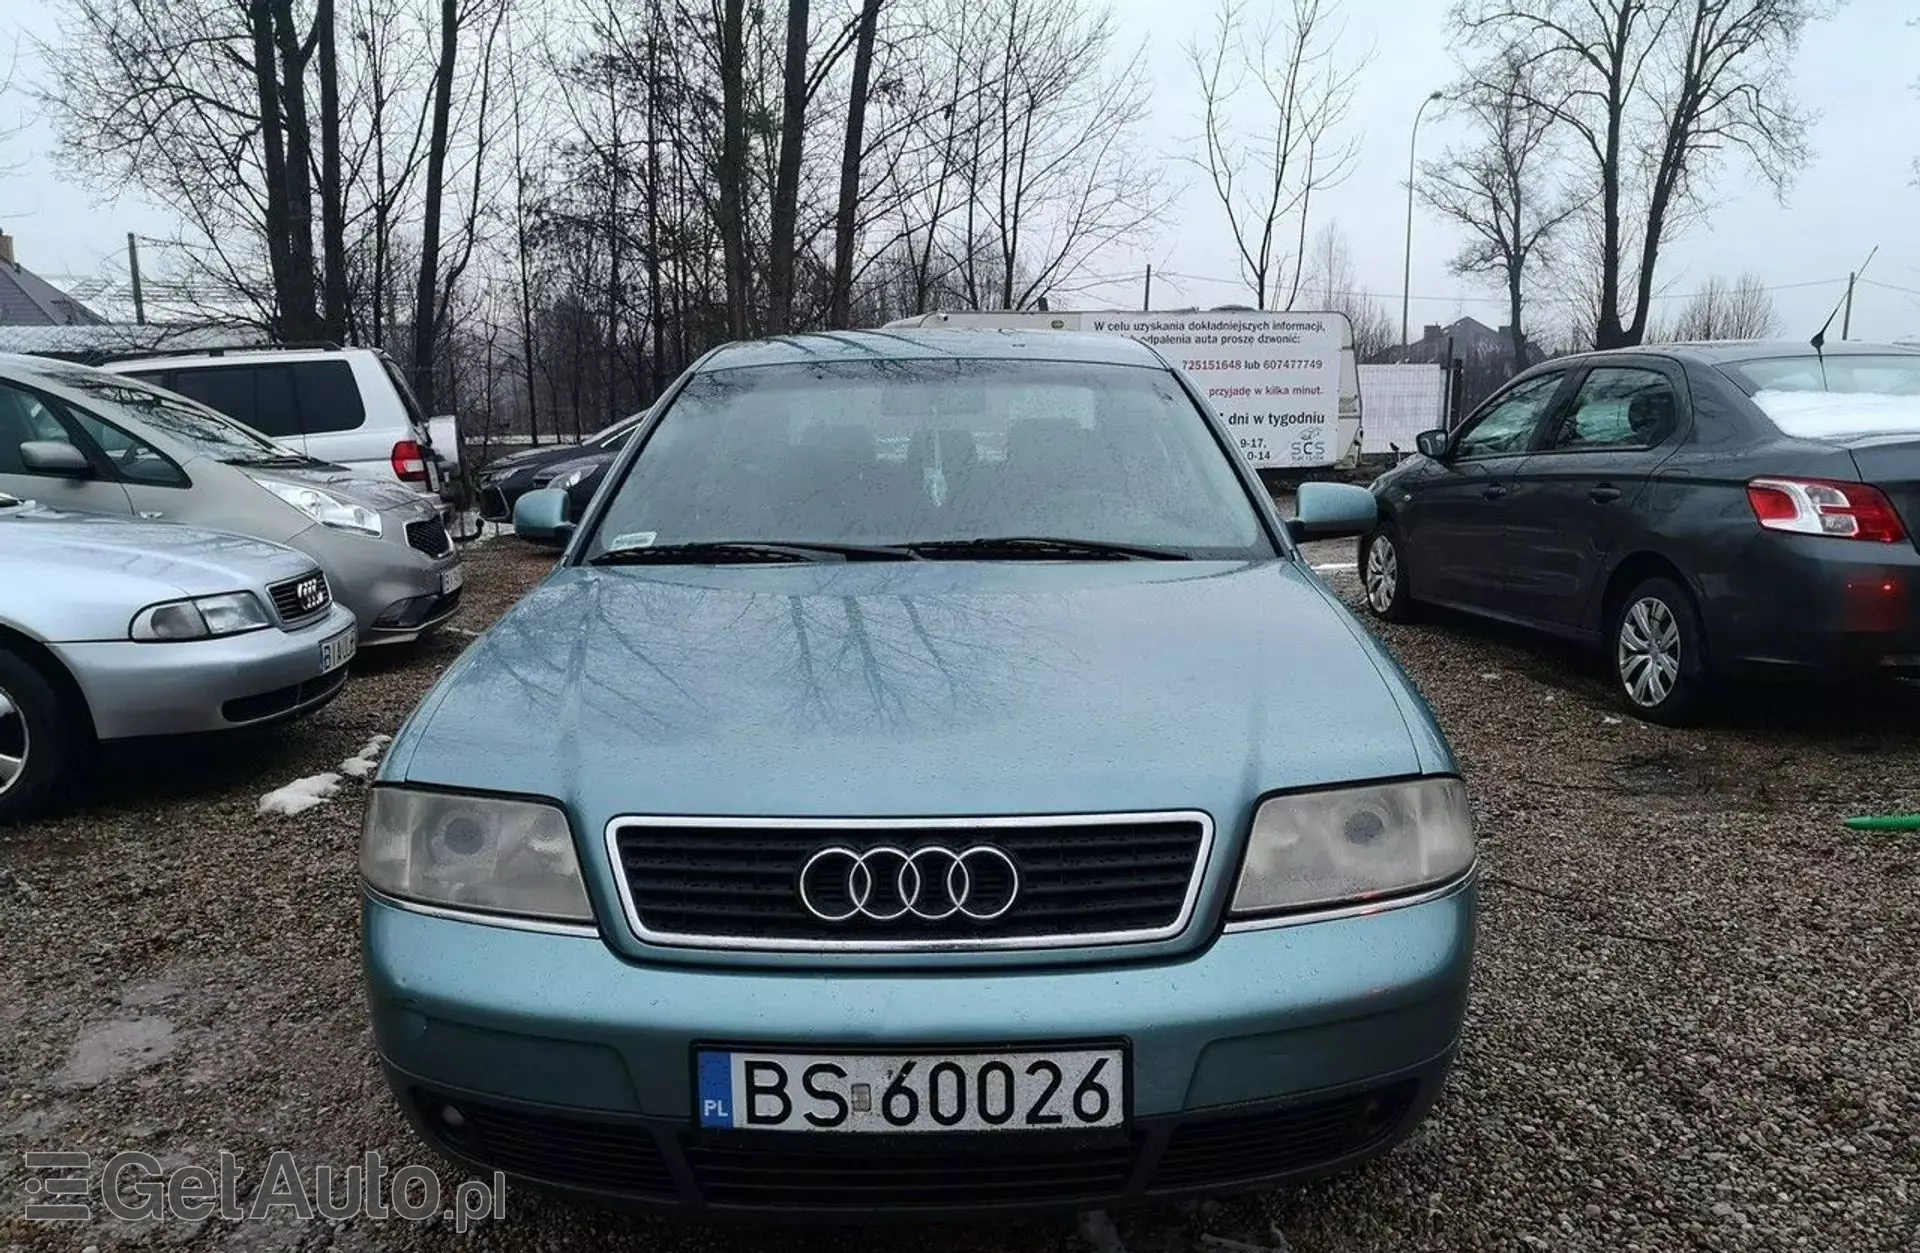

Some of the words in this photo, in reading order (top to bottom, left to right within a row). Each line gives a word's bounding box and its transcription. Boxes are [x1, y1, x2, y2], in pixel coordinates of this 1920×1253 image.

[1093, 321, 1105, 332] W
[1107, 321, 1130, 332] celu
[1133, 321, 1185, 333] uzyskania
[1188, 320, 1270, 333] dokładniejszych
[1272, 320, 1326, 333] informacji,
[1194, 336, 1218, 345] auta
[1182, 360, 1242, 371] 725151648
[1244, 360, 1260, 370] lub
[1263, 359, 1323, 370] 607477749
[1209, 386, 1251, 398] przyjadę
[1254, 387, 1262, 395] w
[1265, 386, 1289, 395] kilka
[1228, 412, 1249, 425] dni
[1253, 415, 1264, 424] w
[1268, 411, 1325, 427] tygodniu
[1291, 441, 1325, 454] SCS
[745, 1060, 849, 1128] BS
[882, 1057, 1111, 1127] 60026
[704, 1100, 728, 1117] PL
